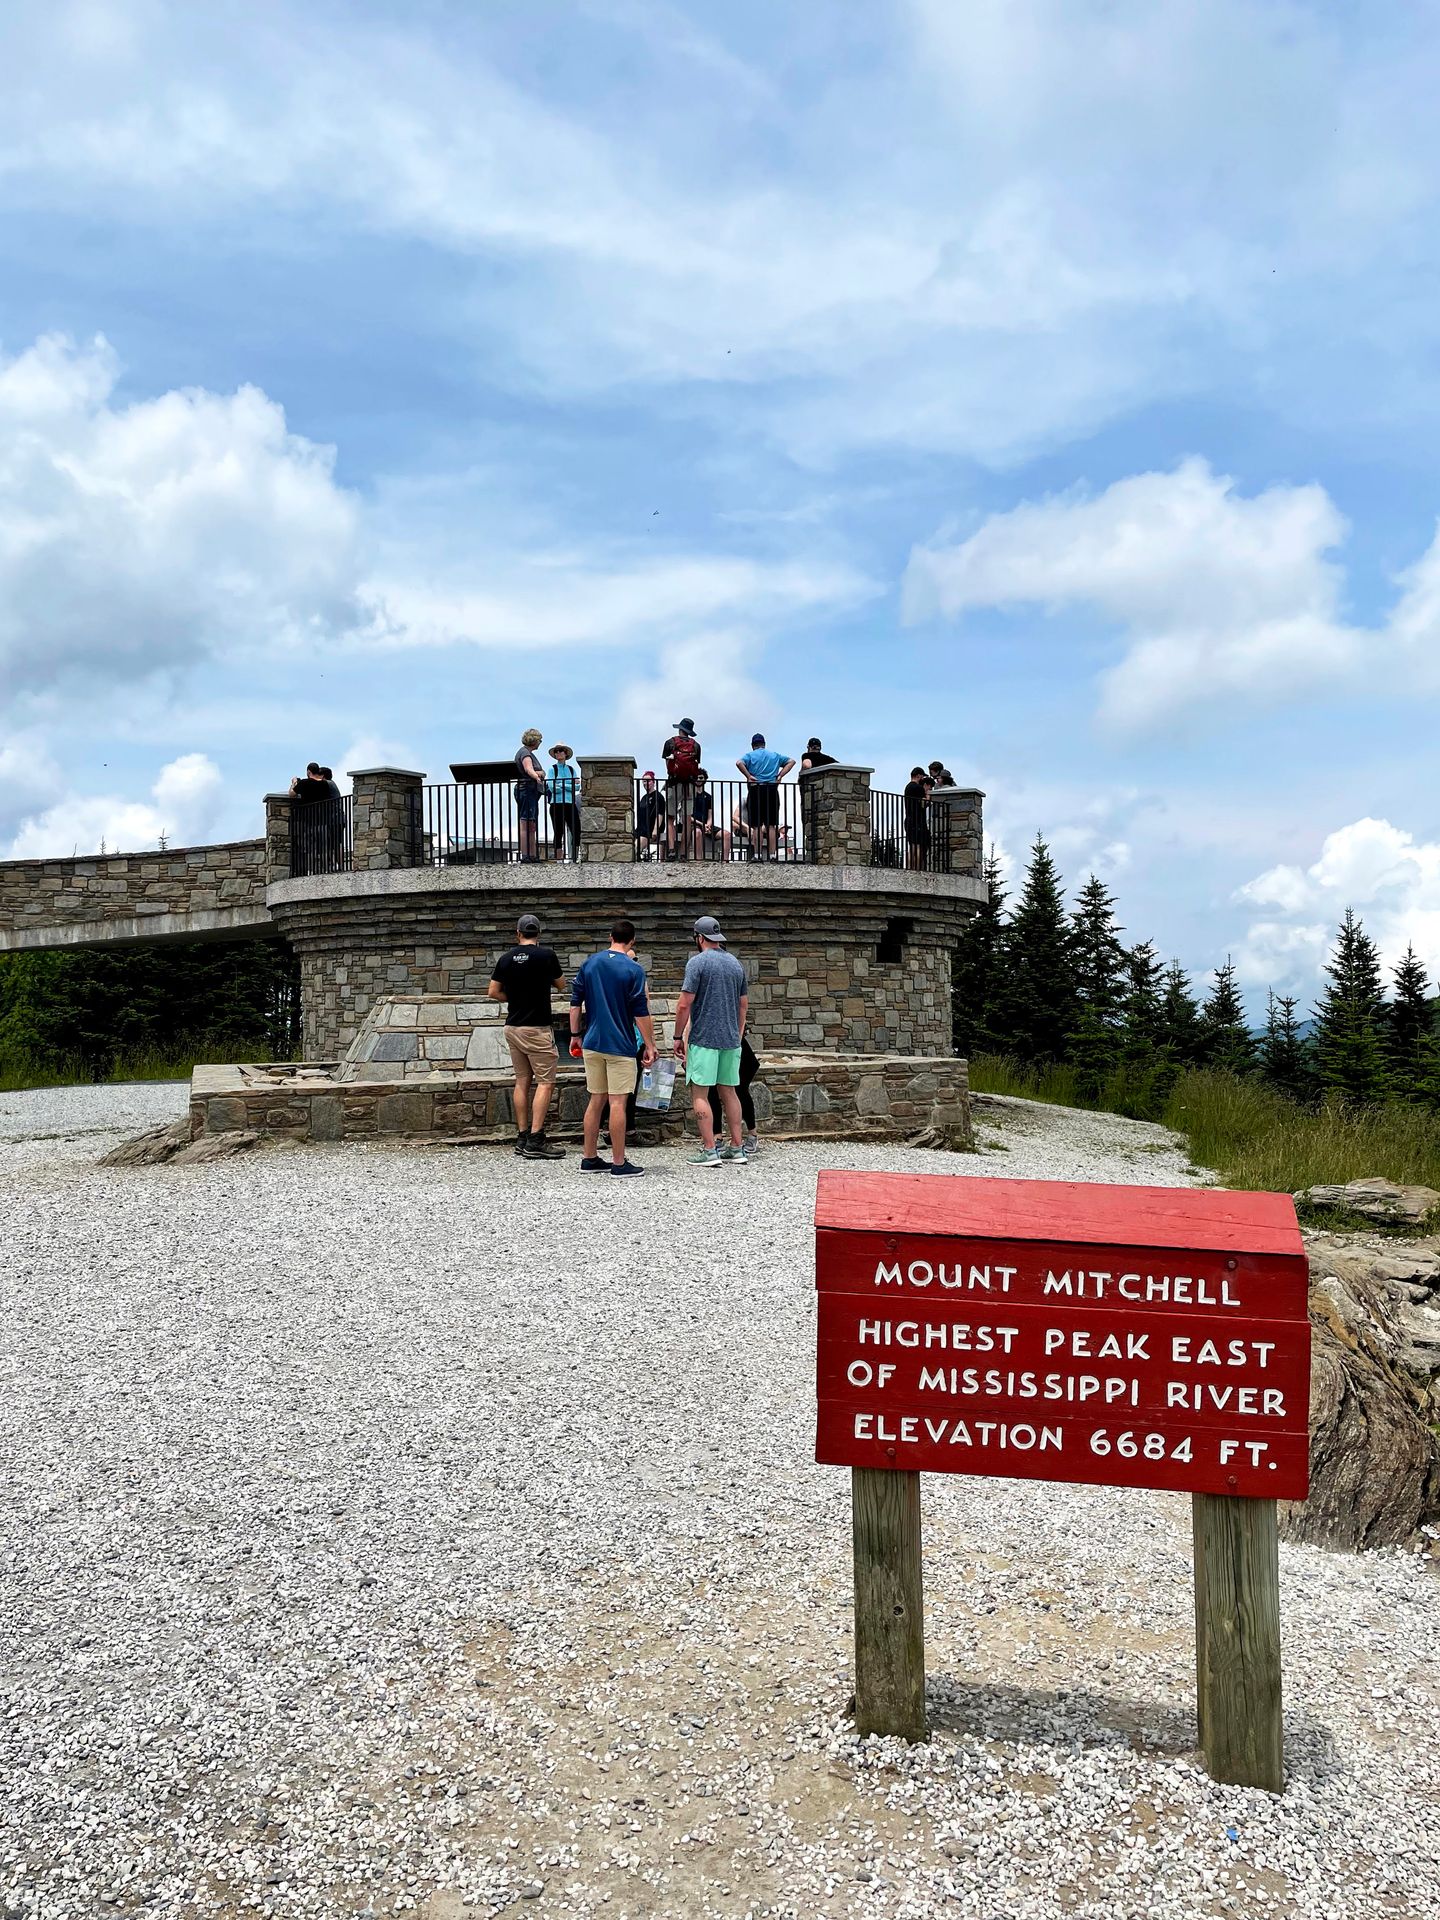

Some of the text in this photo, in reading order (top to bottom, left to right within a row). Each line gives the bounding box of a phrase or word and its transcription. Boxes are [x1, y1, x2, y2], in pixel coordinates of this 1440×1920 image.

[875, 1261, 1240, 1307] MOUNT MITCHELL
[859, 1319, 1275, 1367] HIGHEST PEAK EAST
[847, 1360, 1286, 1416] OF MISSISSIPPI RIVER
[855, 1414, 1276, 1469] ELEVATION 6684 FT.
